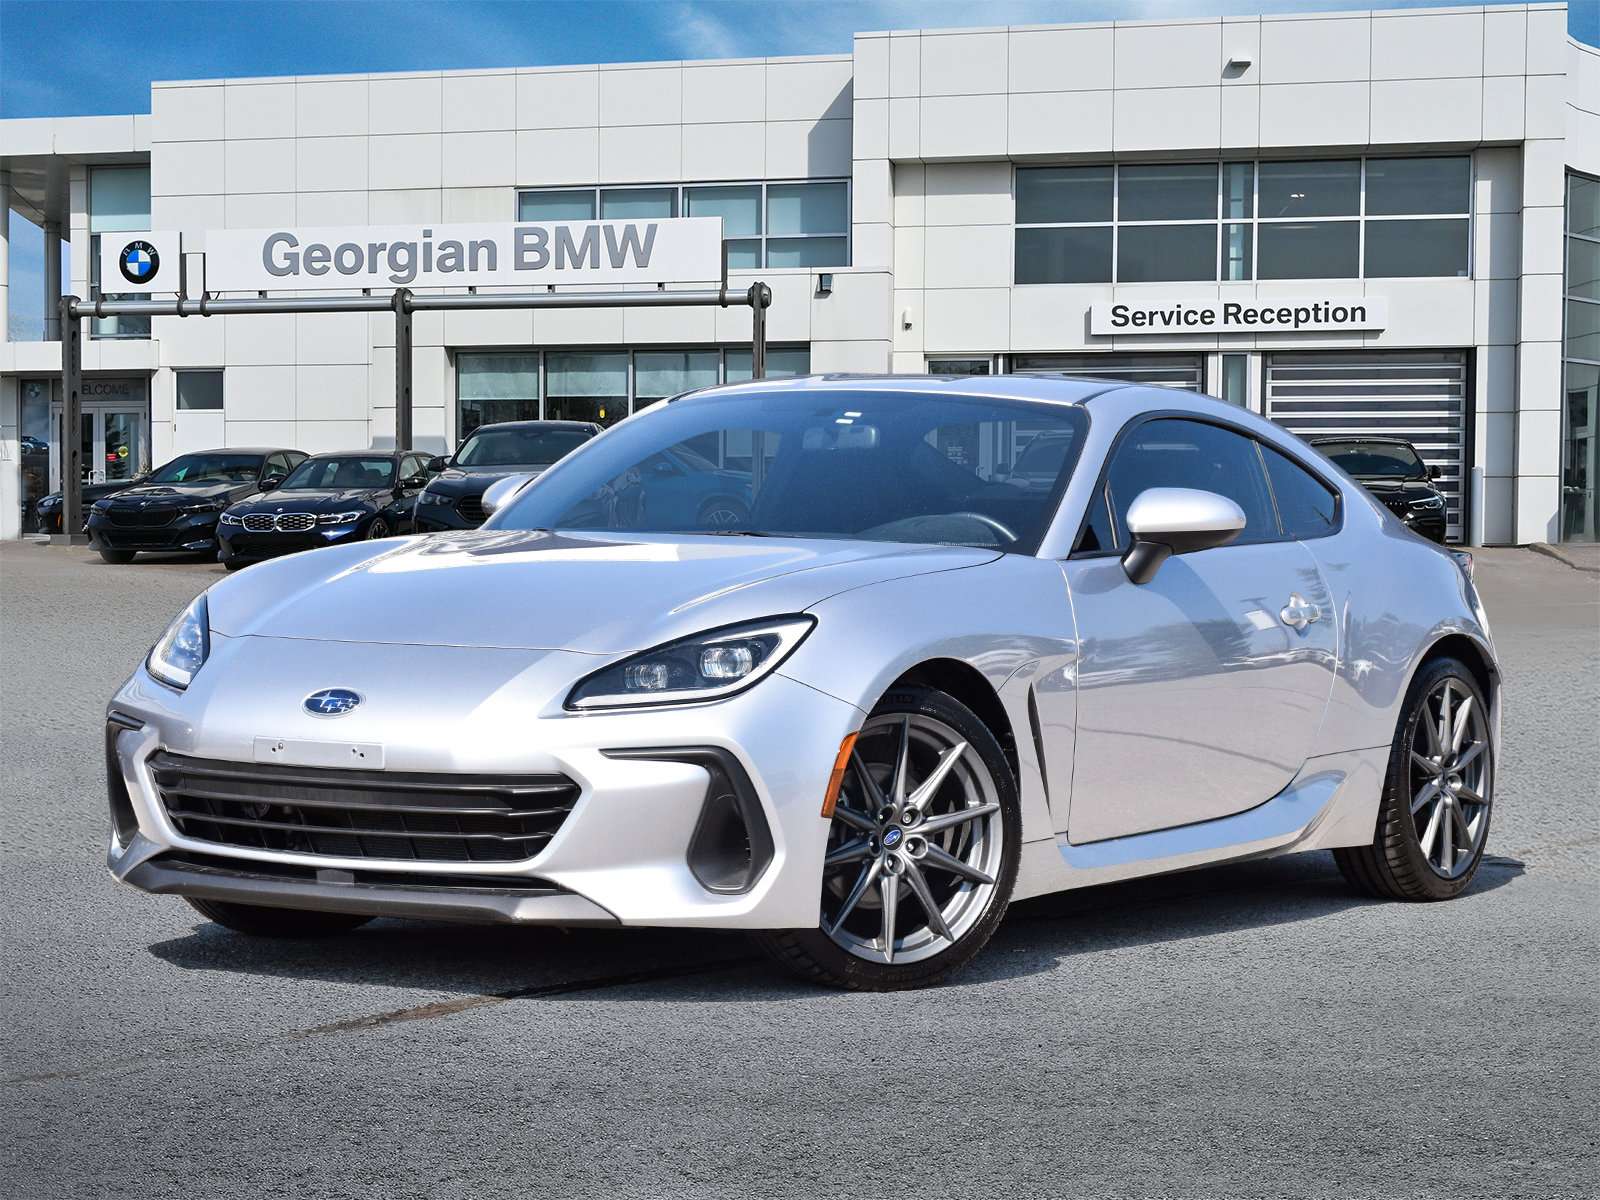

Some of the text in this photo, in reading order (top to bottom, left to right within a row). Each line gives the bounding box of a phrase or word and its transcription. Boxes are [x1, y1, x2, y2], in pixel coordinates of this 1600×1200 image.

[123, 242, 157, 256] BMW
[262, 223, 658, 284] Georgian BMW
[1110, 301, 1367, 328] Service Reception
[81, 383, 129, 396] ELCOME
